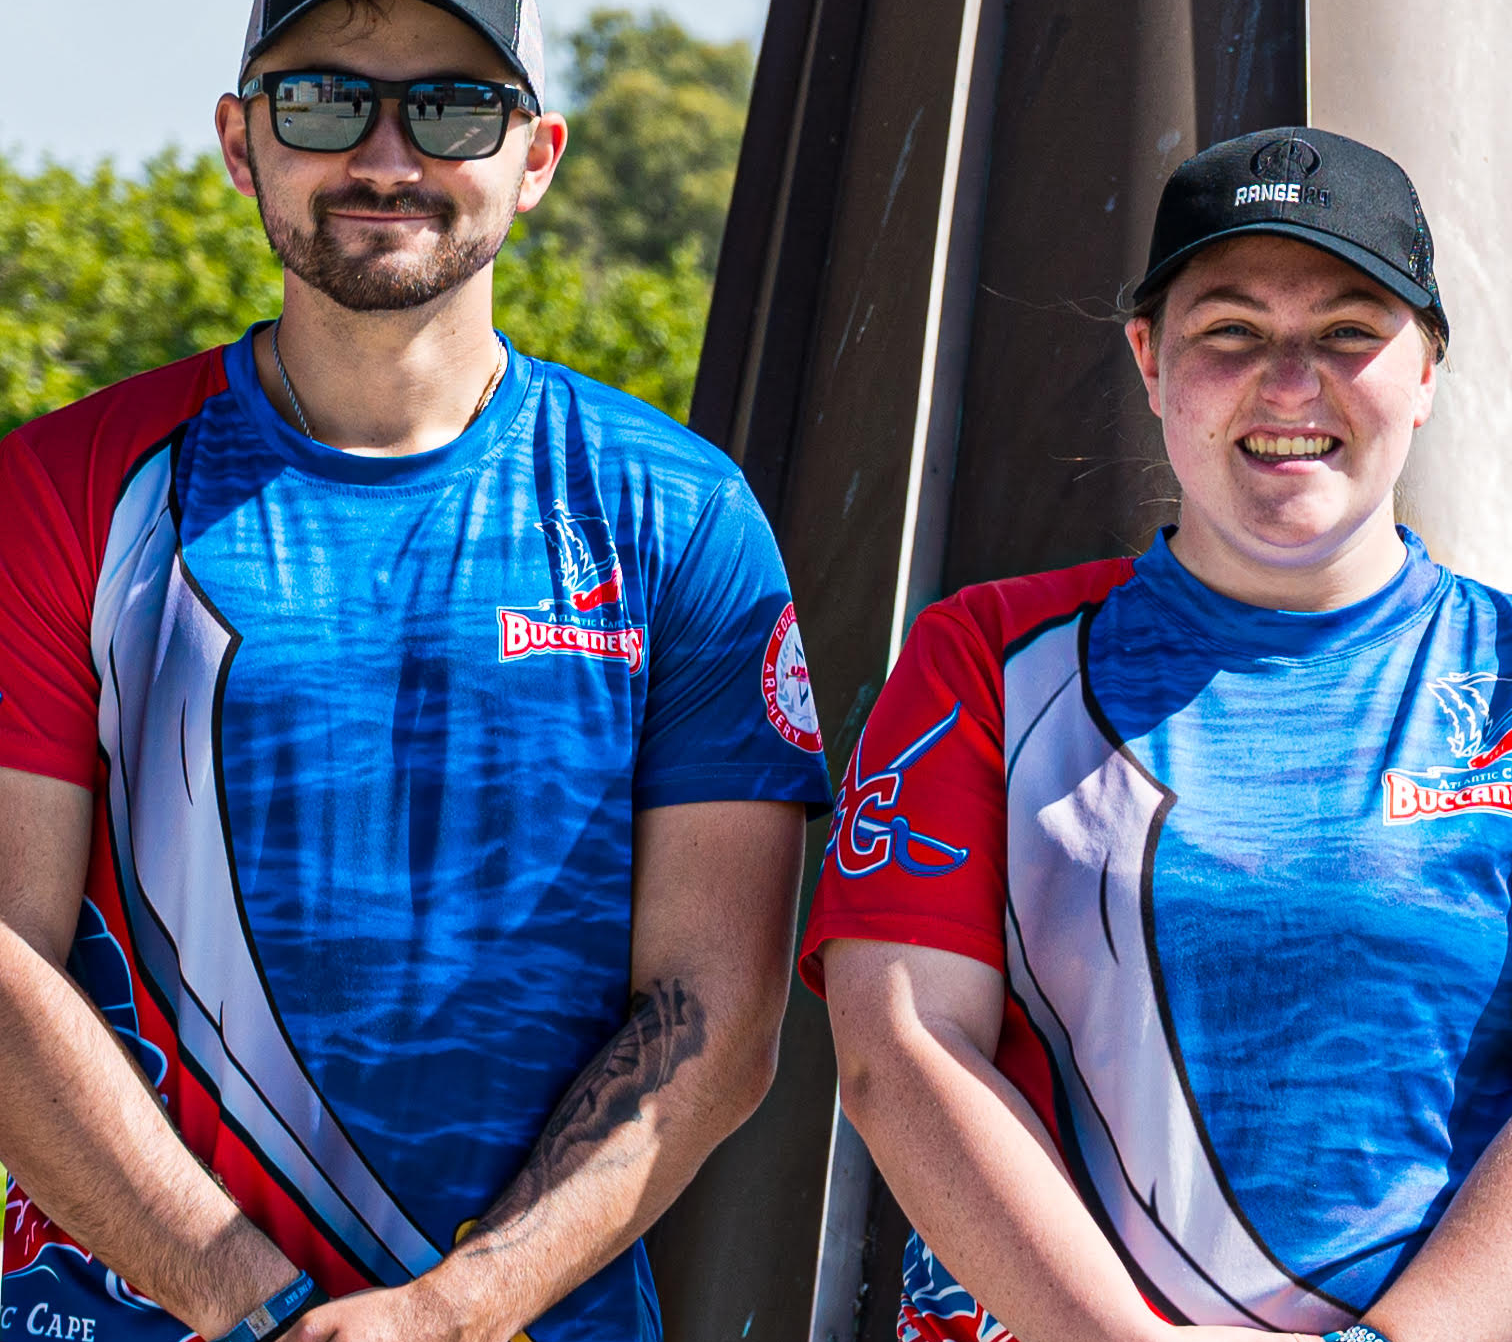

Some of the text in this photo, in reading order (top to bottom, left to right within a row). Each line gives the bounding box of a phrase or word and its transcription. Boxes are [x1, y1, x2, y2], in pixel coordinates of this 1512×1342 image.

[1234, 184, 1301, 207] RANGE
[765, 662, 801, 743] ARCHERY
[1438, 771, 1498, 790] ATLANTIC
[26, 1302, 96, 1342] CAPE
